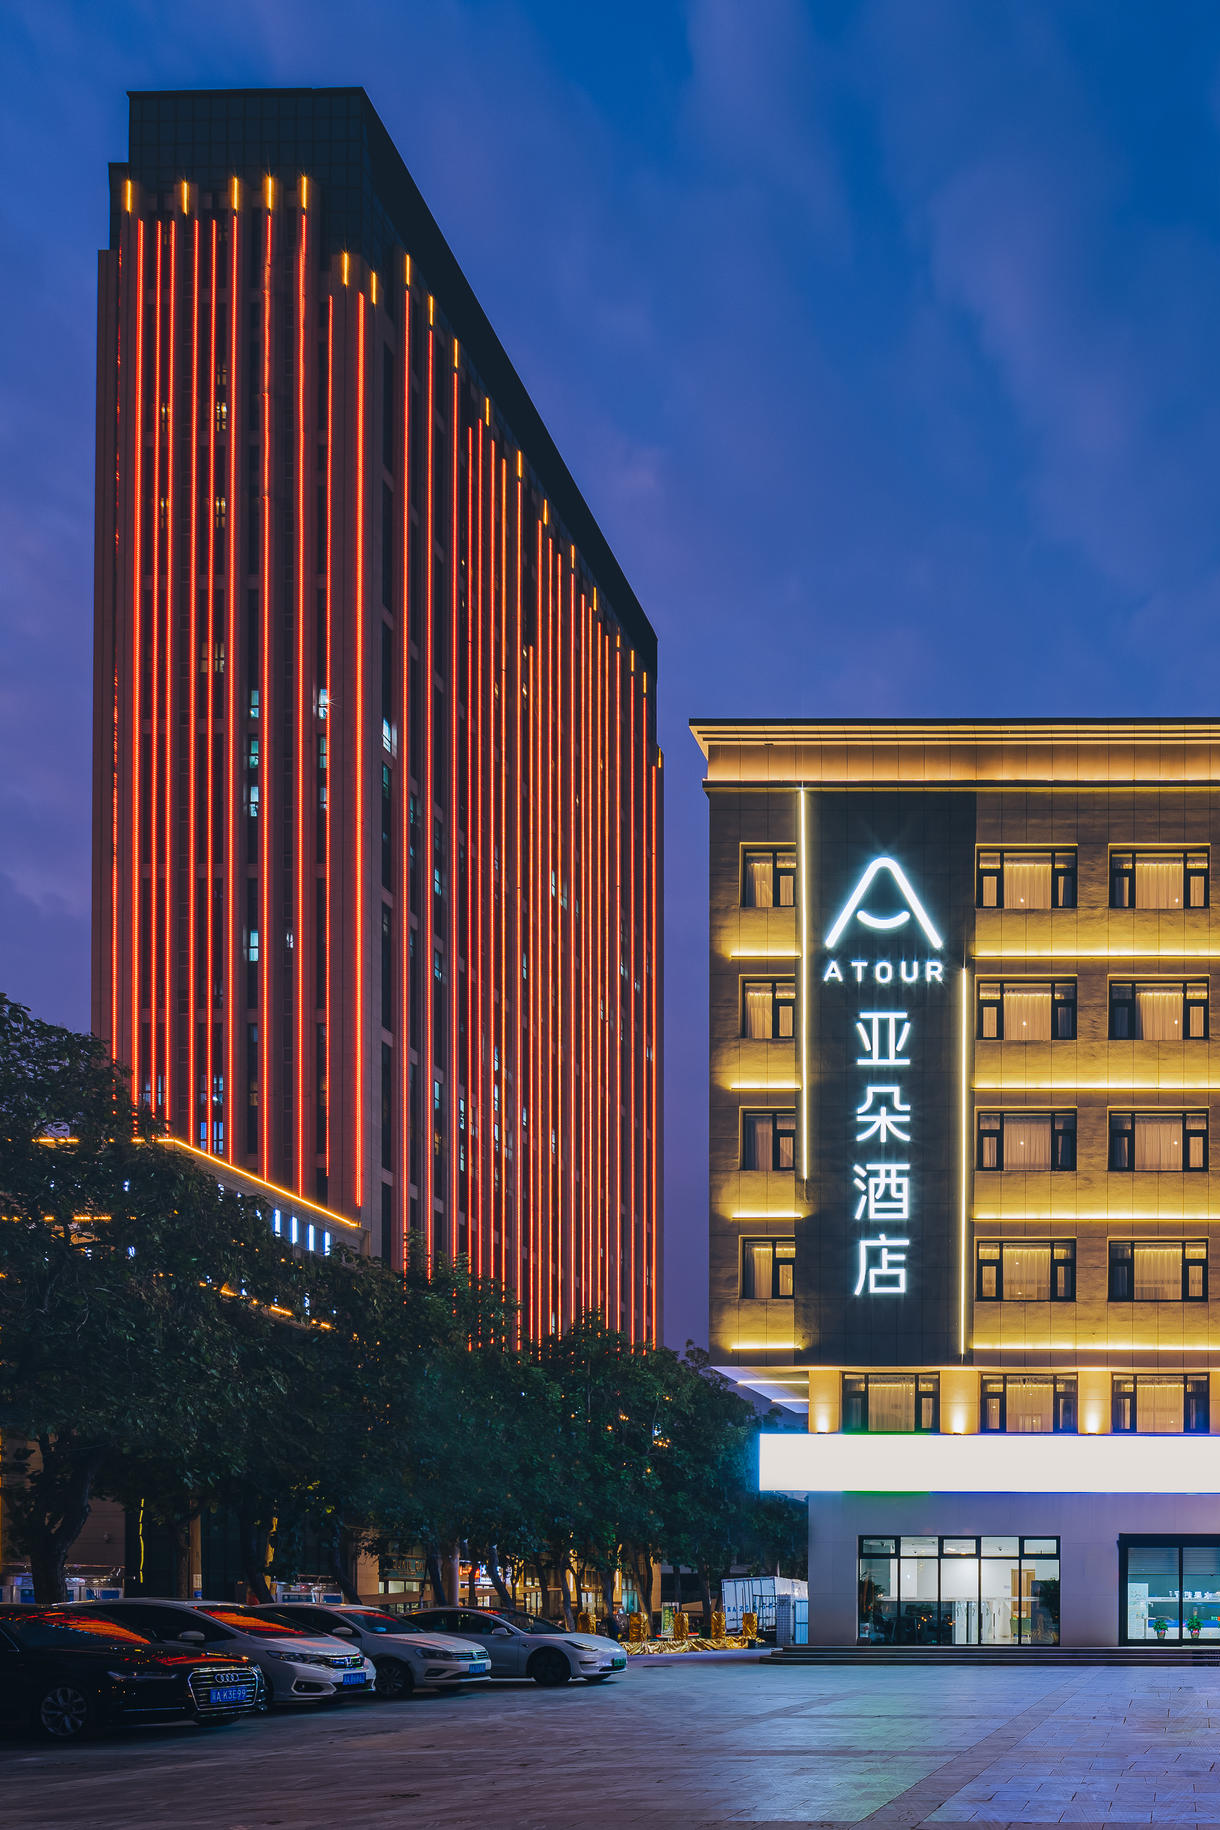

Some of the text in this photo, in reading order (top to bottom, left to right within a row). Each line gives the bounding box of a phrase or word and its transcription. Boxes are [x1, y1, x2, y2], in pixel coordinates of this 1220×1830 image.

[823, 961, 943, 983] ATOUR
[854, 1012, 911, 1296] 亚朵酒店
